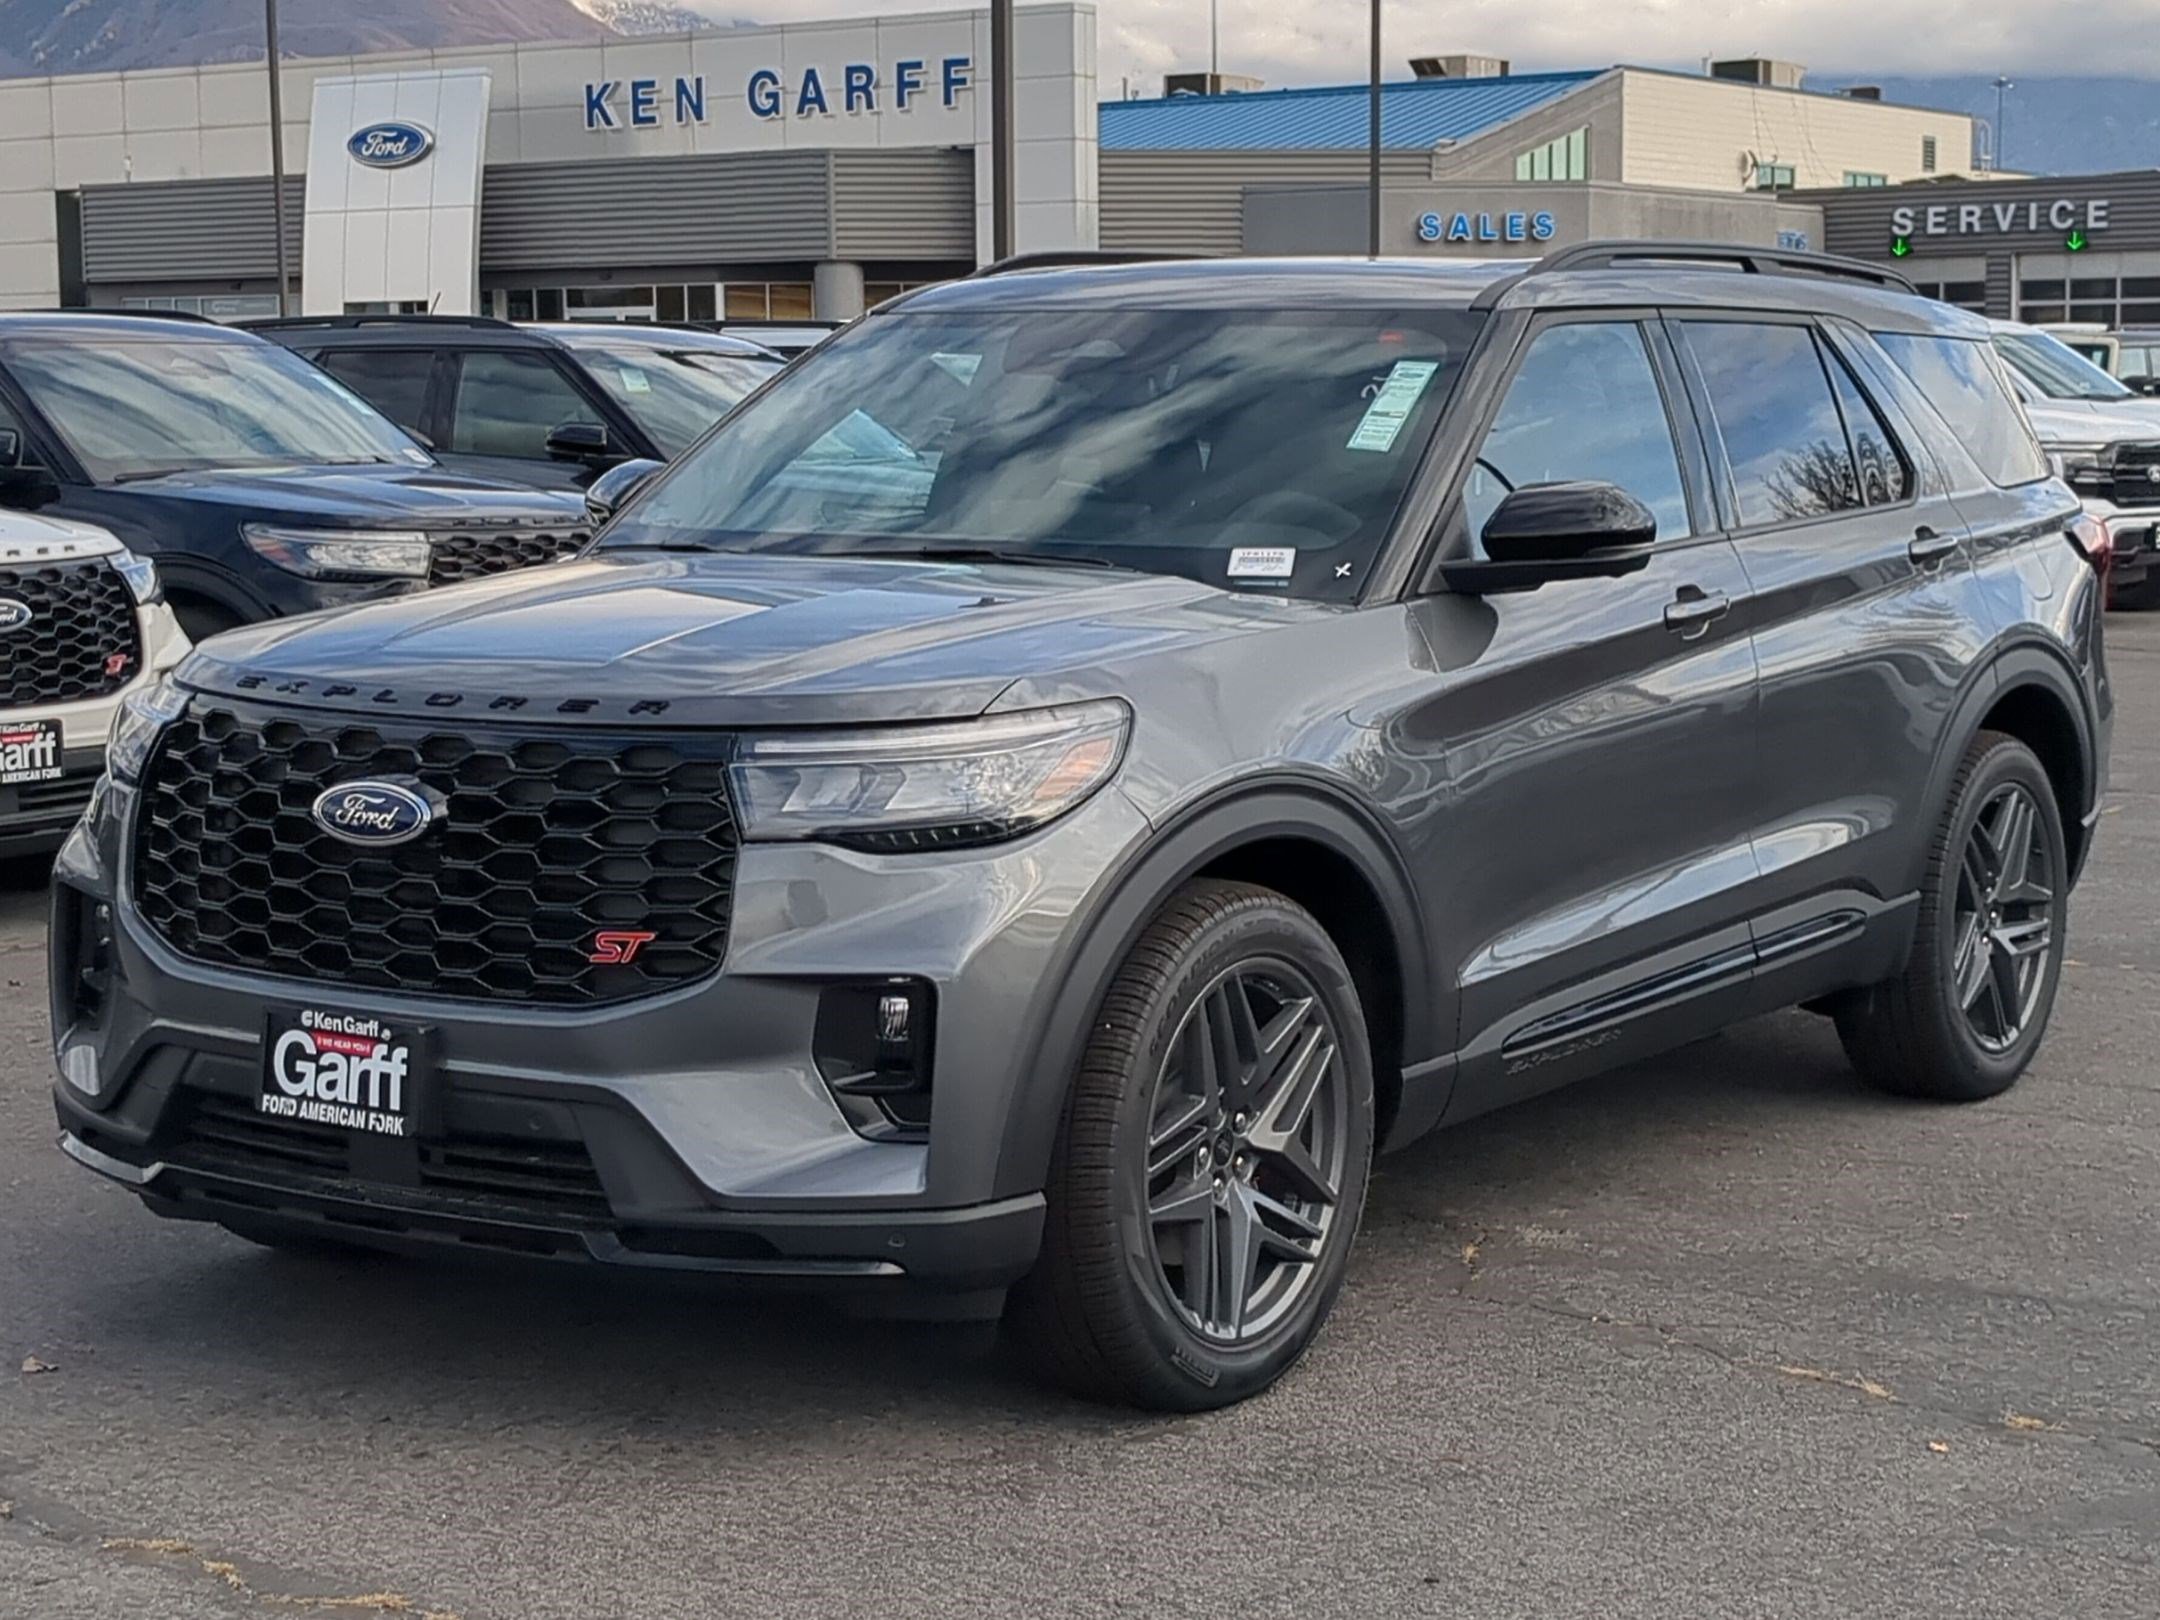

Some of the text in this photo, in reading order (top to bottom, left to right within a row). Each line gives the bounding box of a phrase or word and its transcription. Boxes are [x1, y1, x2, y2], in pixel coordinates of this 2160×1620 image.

[585, 57, 971, 129] KEN GARFF
[361, 131, 409, 156] Ford
[1419, 211, 1557, 242] SALES
[1891, 199, 2110, 236] SERVICE
[236, 675, 672, 716] EXPLORER
[0, 731, 56, 771] arff
[335, 793, 400, 830] Ford
[589, 931, 656, 964] ST
[314, 1011, 379, 1038] Ken Garff
[273, 1029, 408, 1111] Garff
[262, 1093, 405, 1137] FORD AMERICAN FORK
